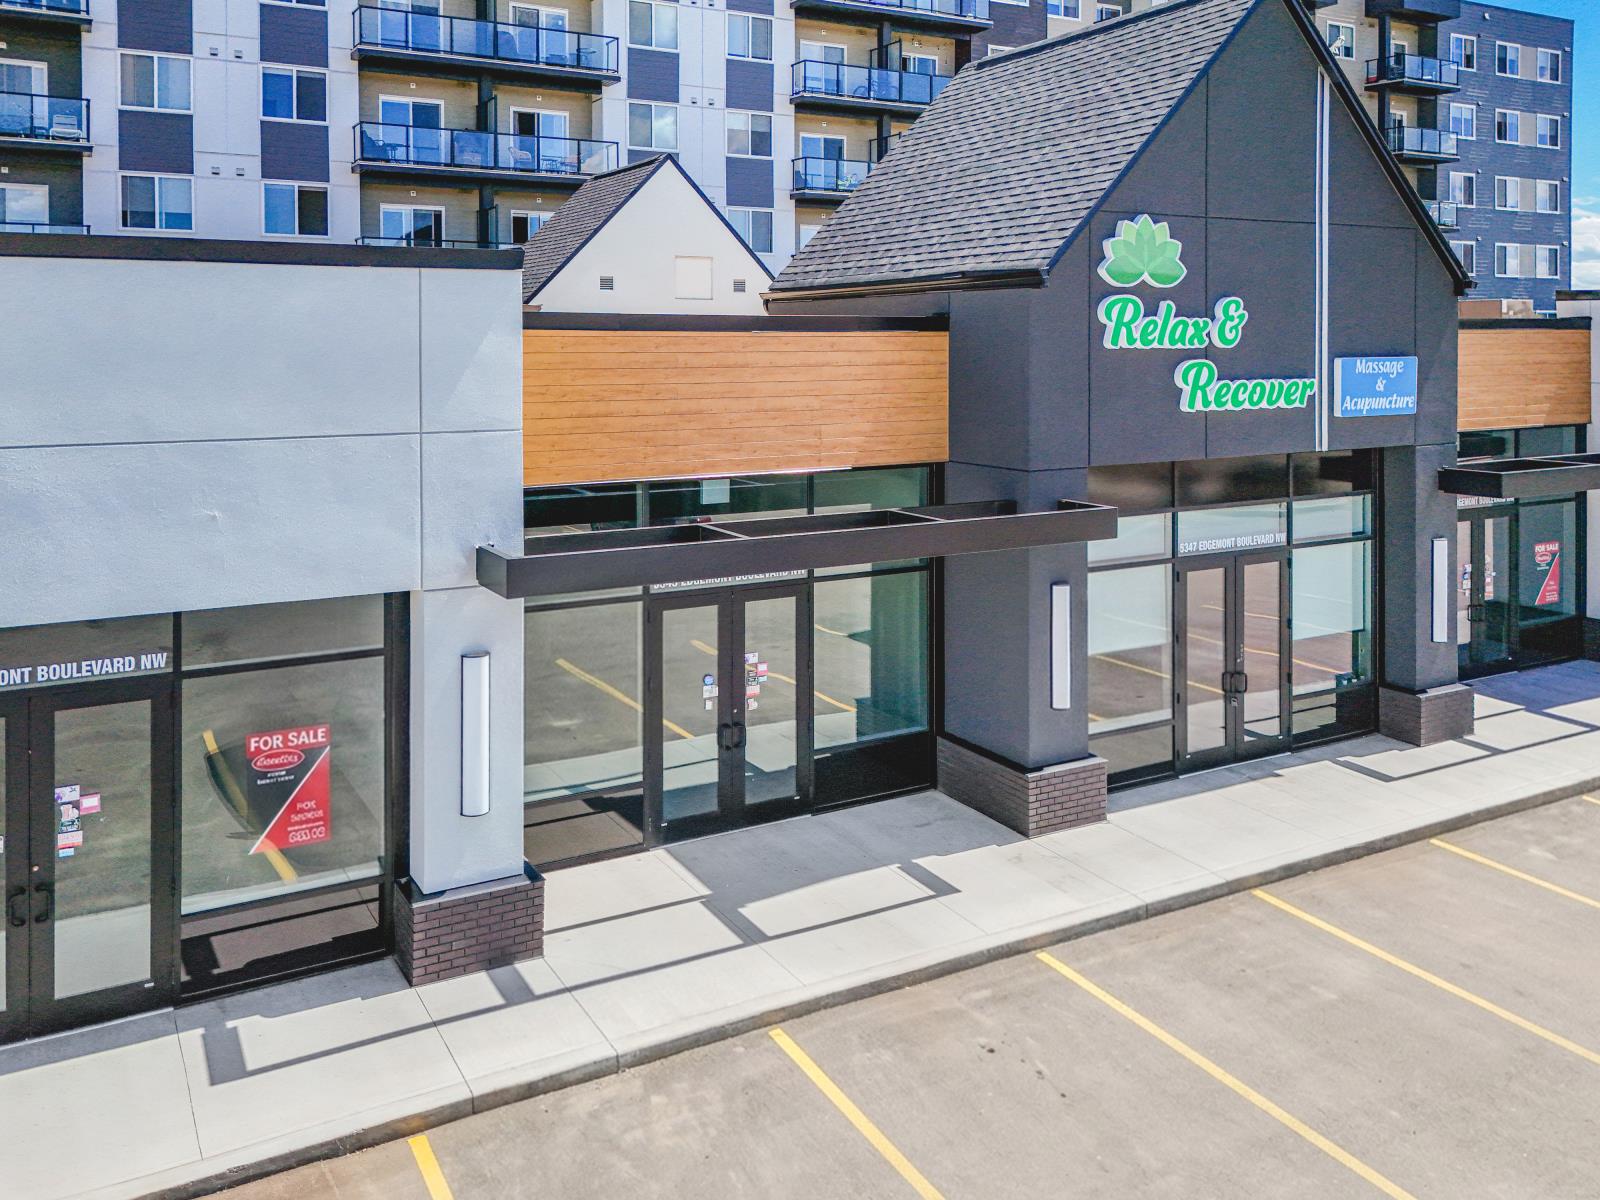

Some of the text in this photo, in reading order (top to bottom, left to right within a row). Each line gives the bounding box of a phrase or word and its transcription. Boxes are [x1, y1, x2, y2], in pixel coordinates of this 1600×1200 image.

[1099, 295, 1247, 349] Relax &
[1355, 358, 1404, 378] Massage
[1177, 360, 1316, 412] Recover
[1375, 377, 1387, 391] &
[1342, 393, 1415, 414] Acupuncture
[1198, 537, 1235, 551] EDGEMONT
[1236, 533, 1274, 547] BOULEVARD
[1275, 532, 1287, 543] NW
[1546, 543, 1558, 551] SALE
[37, 656, 136, 682] BOULEVARD
[140, 652, 168, 669] NW
[250, 728, 327, 751] FOR SALE
